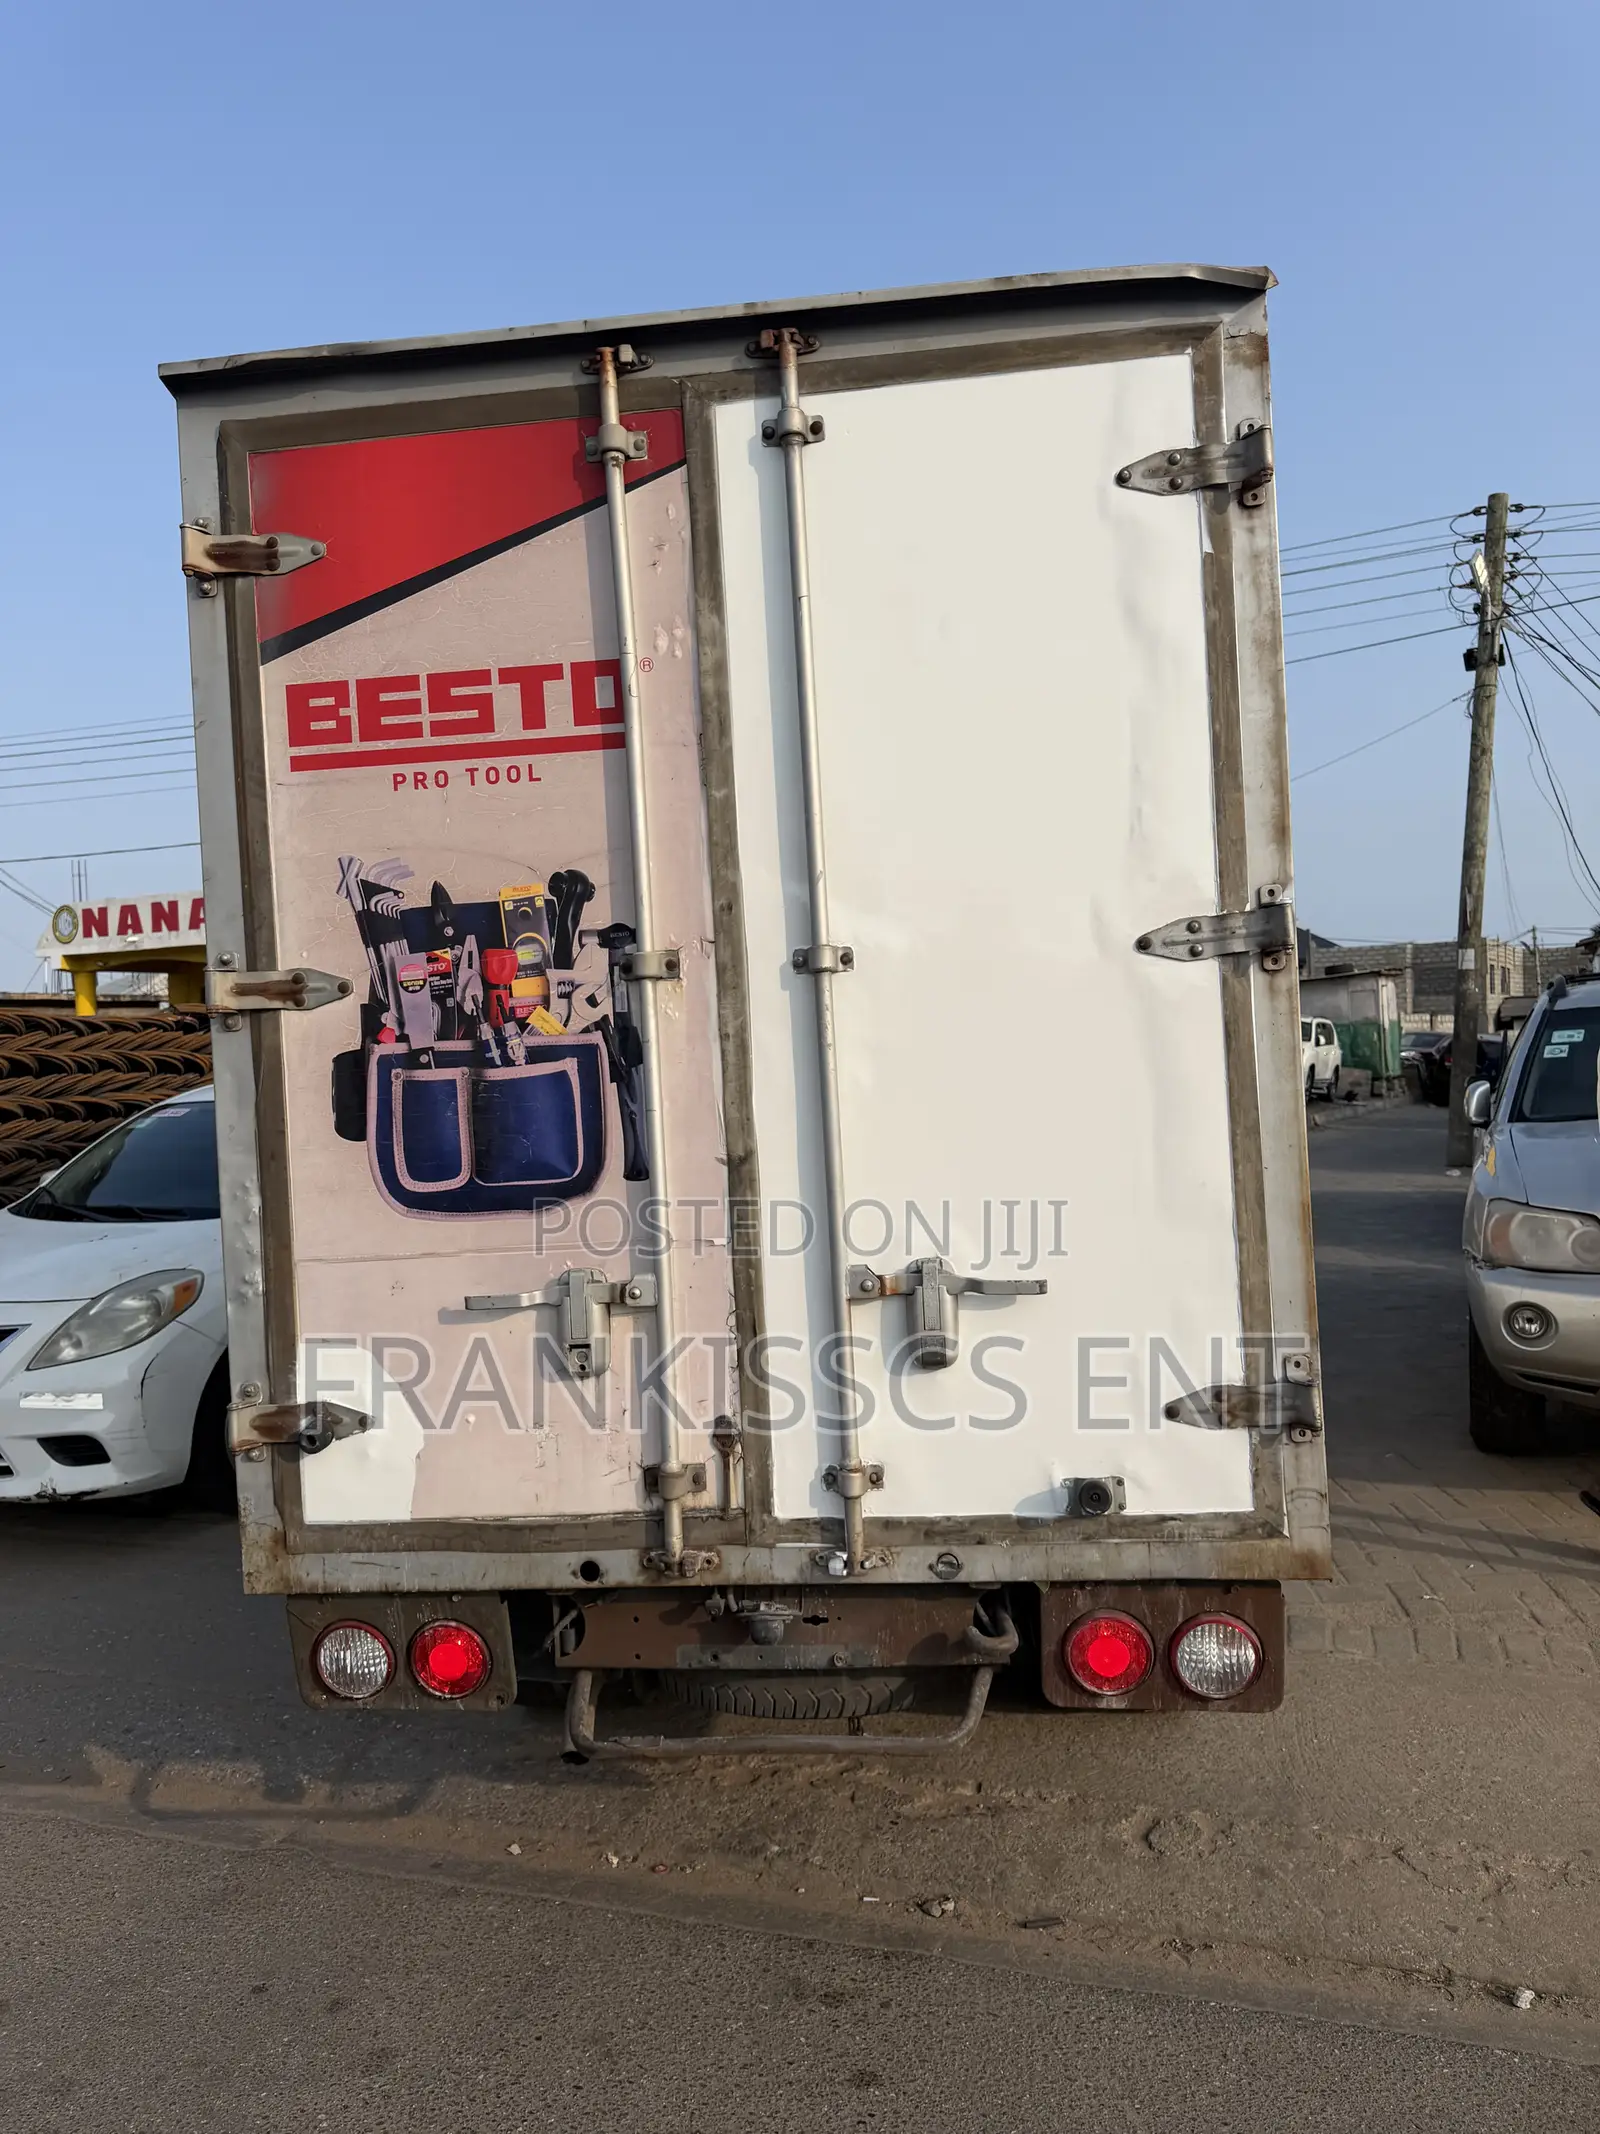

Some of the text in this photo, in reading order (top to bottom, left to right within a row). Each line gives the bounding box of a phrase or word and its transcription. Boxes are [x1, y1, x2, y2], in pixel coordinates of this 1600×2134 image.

[285, 658, 624, 748] BESTO
[392, 763, 543, 792] PRO TOOL
[81, 897, 207, 939] NANA
